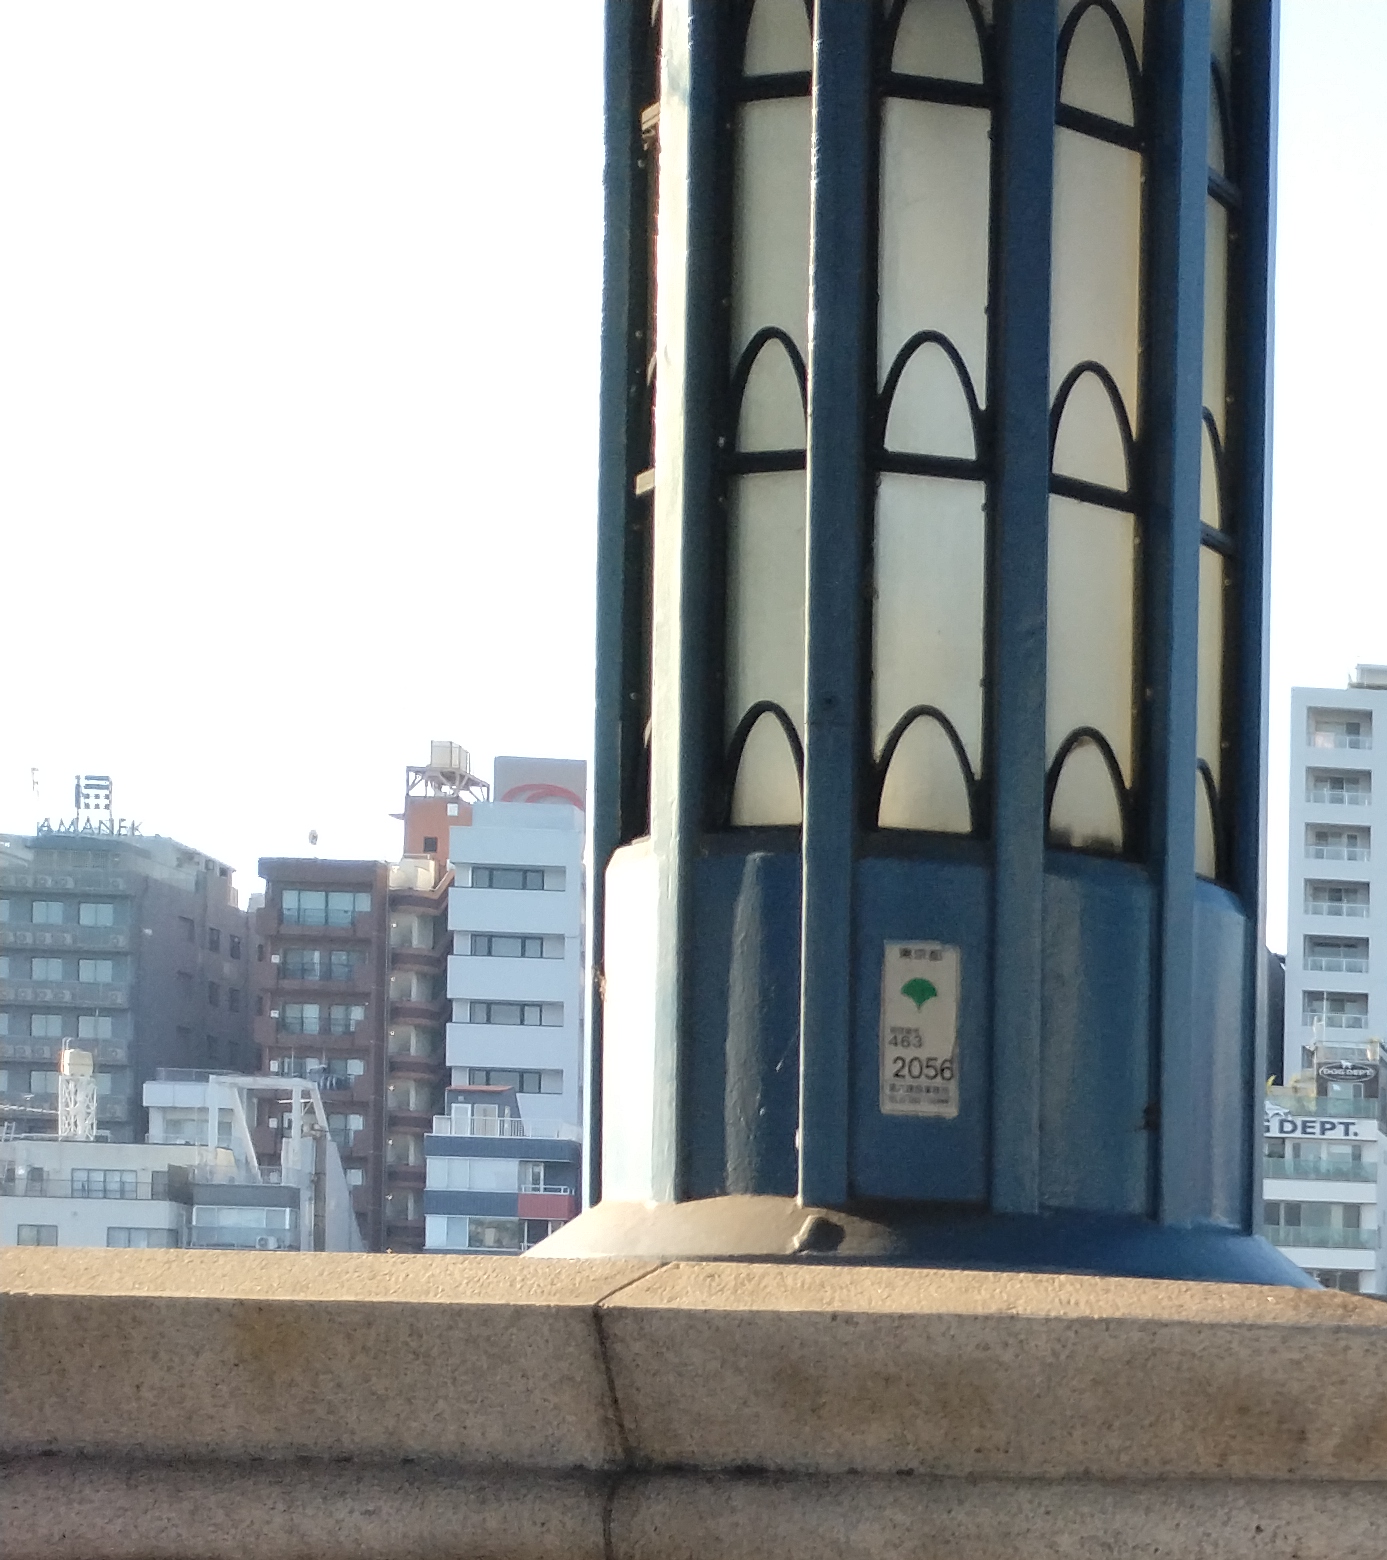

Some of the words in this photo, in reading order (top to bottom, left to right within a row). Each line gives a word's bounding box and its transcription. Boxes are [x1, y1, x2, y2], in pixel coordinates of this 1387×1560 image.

[39, 817, 143, 836] AMANEK
[888, 1035, 922, 1049] 463
[893, 1055, 954, 1081] 2056
[1278, 1119, 1359, 1137] DEPT.
